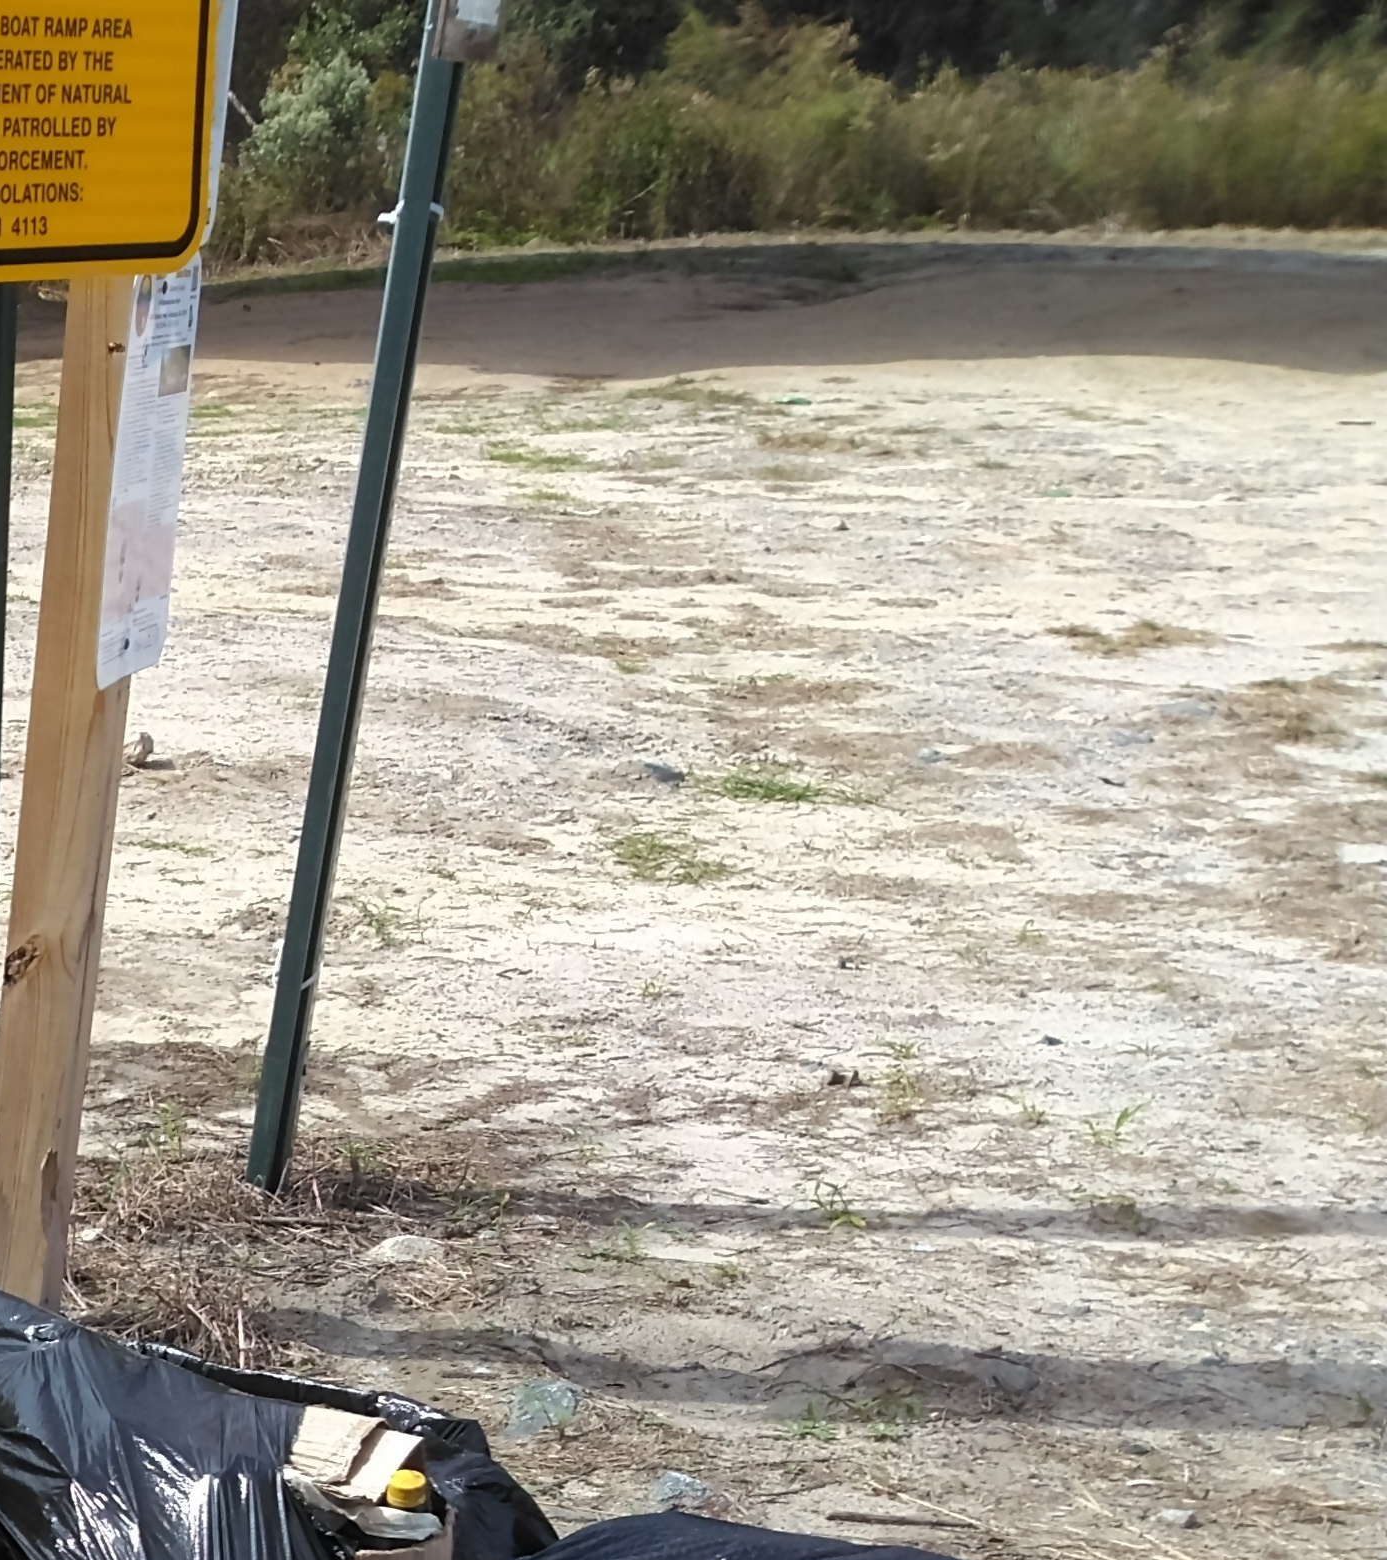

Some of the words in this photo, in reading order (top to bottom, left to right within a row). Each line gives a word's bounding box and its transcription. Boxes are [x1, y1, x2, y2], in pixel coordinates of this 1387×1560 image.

[0, 16, 39, 37] BOAT
[44, 17, 88, 38] RAMP
[92, 19, 133, 38] AREA
[58, 50, 77, 71] BY
[83, 51, 114, 71] THE
[35, 84, 56, 104] OF
[61, 84, 132, 104] NATURAL
[3, 117, 92, 137] PATROLLED
[97, 116, 117, 136] BY
[11, 216, 48, 236] 4113
